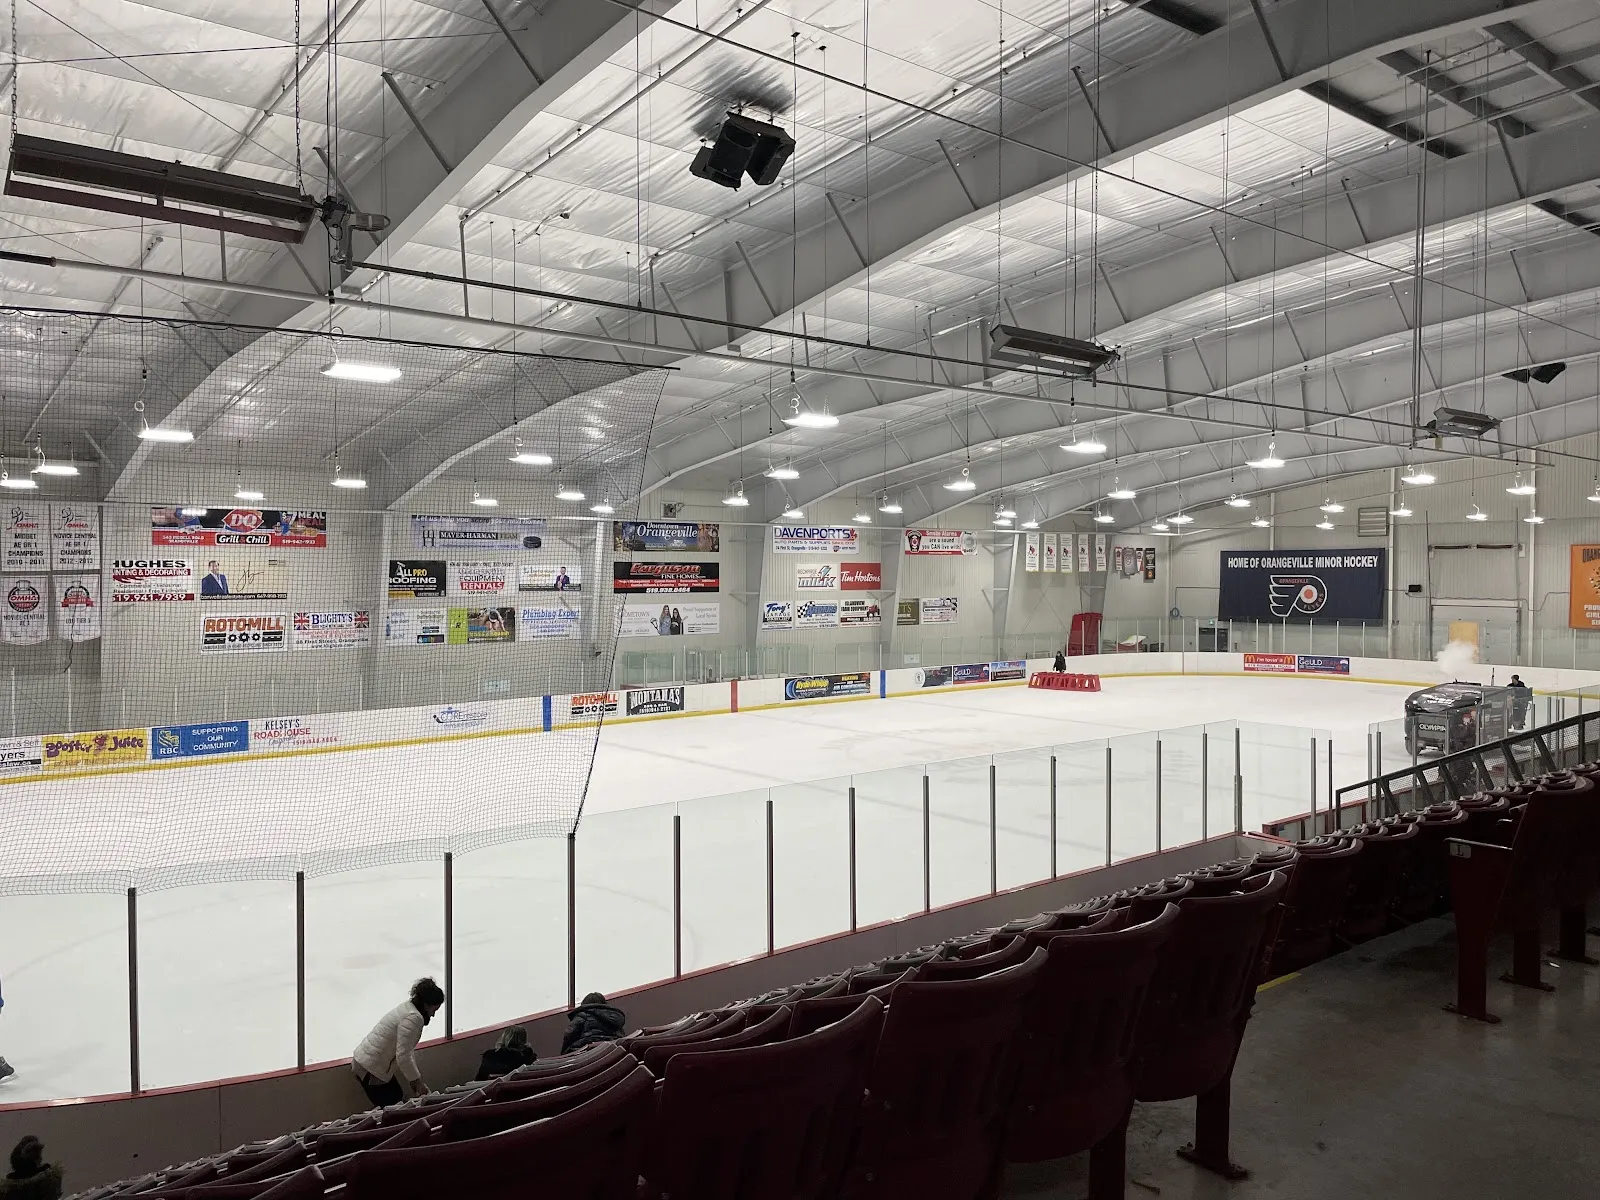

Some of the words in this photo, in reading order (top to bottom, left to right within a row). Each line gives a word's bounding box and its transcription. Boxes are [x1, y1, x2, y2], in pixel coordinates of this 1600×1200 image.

[231, 512, 257, 526] DQ
[637, 525, 698, 540] Orangeville
[774, 528, 850, 539] DAVENPORTS
[218, 536, 240, 544] Grill
[246, 536, 268, 544] Chill
[1228, 558, 1248, 568] HOME
[1250, 558, 1260, 568] OF
[1261, 557, 1313, 568] ORANGEVILLE
[1315, 557, 1342, 568] MINOR
[1344, 556, 1378, 568] HOCKEY
[841, 572, 855, 583] Tim
[856, 572, 881, 583] Hortons
[312, 614, 353, 624] BLIGHTY'S
[630, 688, 680, 708] MONTANA'S
[266, 719, 300, 730] KELSEY'S
[1419, 724, 1446, 732] OLYMPIA
[192, 726, 238, 735] SUPPORTING
[254, 728, 310, 739] ROADHOUSE
[108, 737, 143, 750] Juice
[194, 740, 238, 750] COMMUNITY
